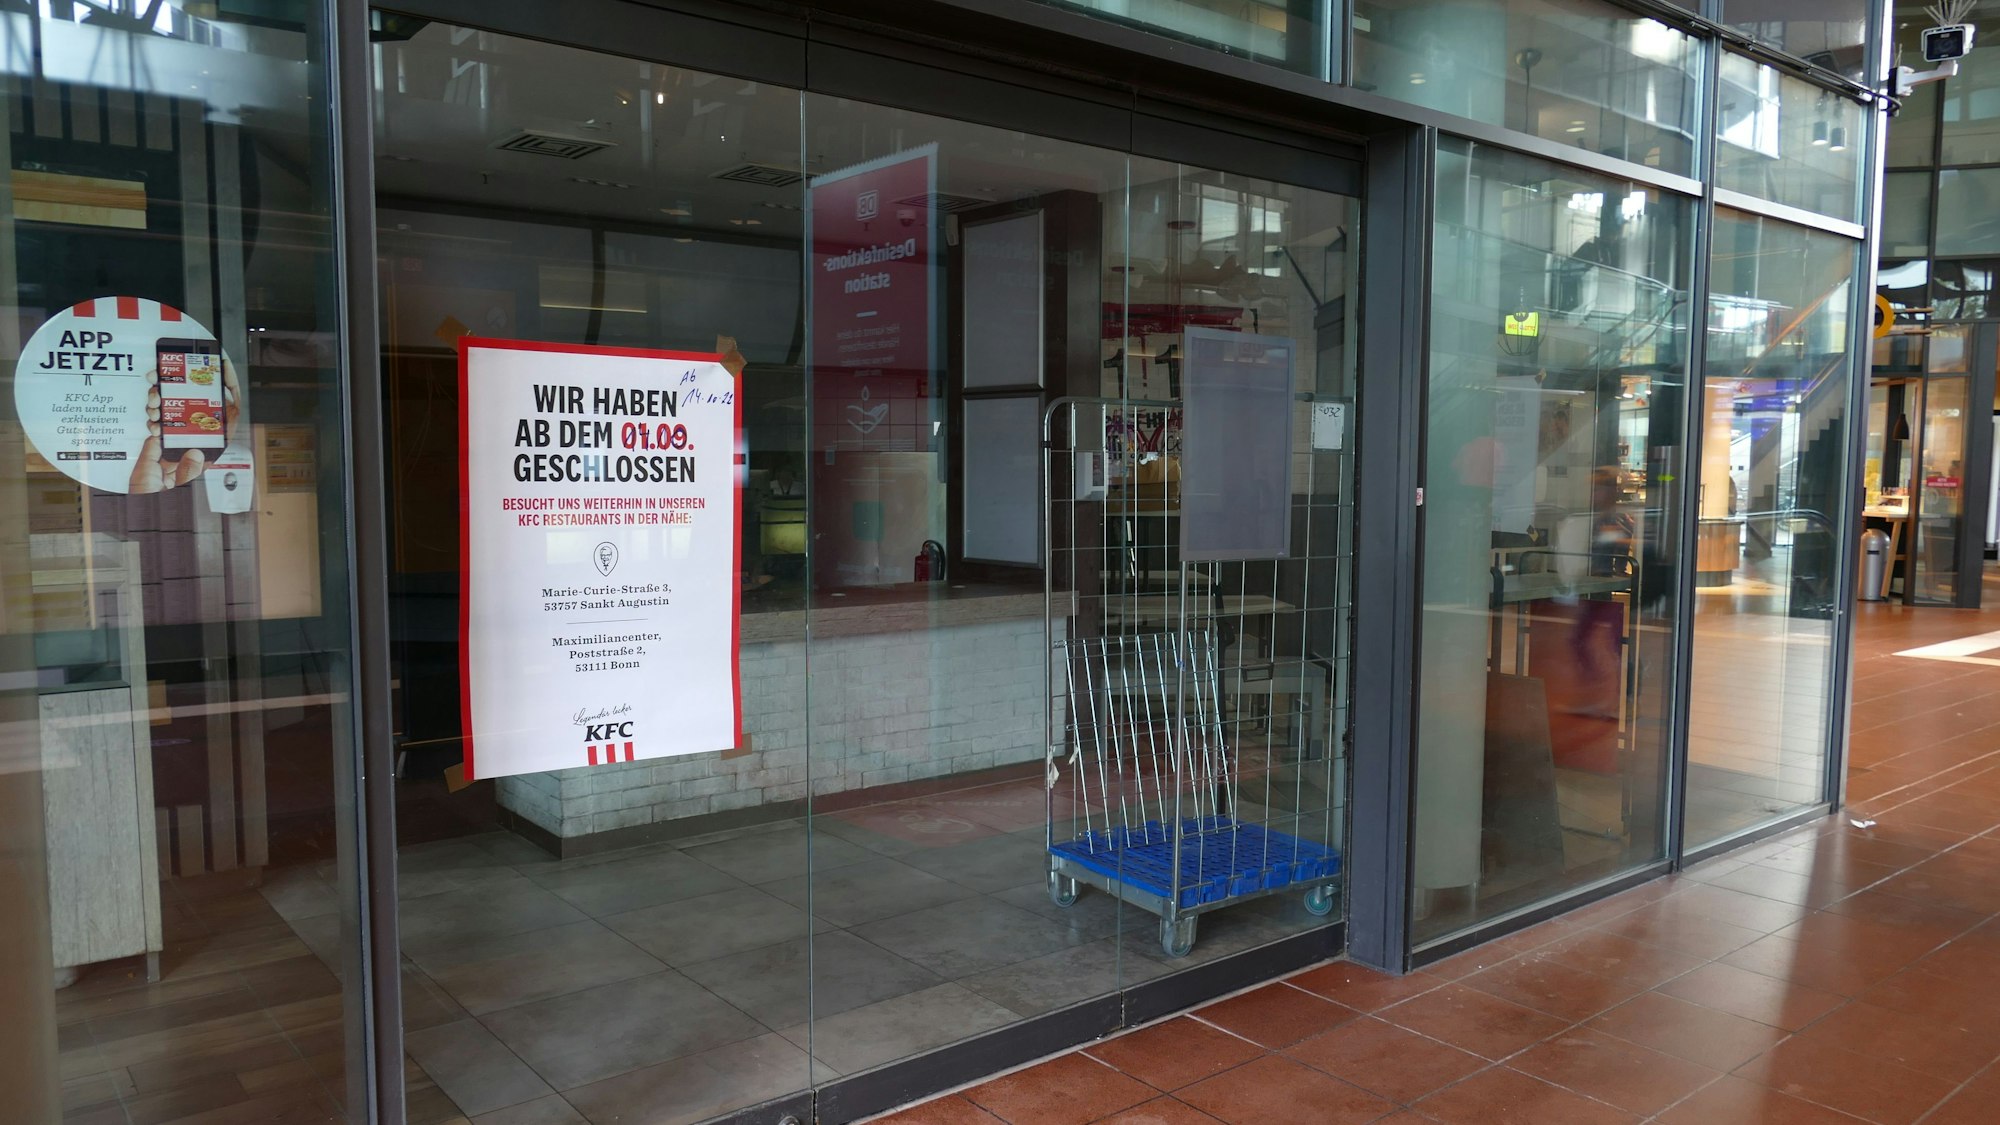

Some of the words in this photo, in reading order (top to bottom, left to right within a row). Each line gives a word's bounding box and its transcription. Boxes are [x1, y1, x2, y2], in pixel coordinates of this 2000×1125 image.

[59, 330, 113, 349] APP
[39, 351, 134, 371] JETZT!
[680, 368, 696, 385] Ab
[64, 393, 90, 402] KFC
[92, 394, 114, 404] App
[164, 399, 185, 407] KFC
[533, 384, 584, 414] WIR
[593, 387, 677, 417] HABEN
[51, 404, 82, 413] laden
[85, 404, 106, 413] und
[108, 405, 127, 414] mit
[61, 415, 119, 424] exklusiven
[56, 425, 125, 435] Gutscheinen
[515, 419, 550, 447] AB
[559, 420, 612, 448] DEM
[71, 437, 112, 446] sparen!
[513, 454, 696, 482] GESCHLOSSEN
[503, 498, 554, 510] BESUCHT
[558, 498, 580, 510] UNS
[583, 498, 642, 510] WEITERHIN
[646, 498, 656, 509] IN
[659, 497, 705, 509] UNSEREN
[518, 514, 540, 526] KFC
[543, 513, 621, 526] RESTAURANTS
[624, 513, 635, 525] IN
[638, 513, 658, 524] DER
[661, 510, 692, 524] NÄHE:
[541, 584, 660, 597] Marie-Curie-Straße
[662, 583, 672, 594] 3,
[544, 601, 578, 611] 53757
[580, 599, 615, 610] Sankt
[617, 596, 670, 608] Augustin
[552, 633, 662, 647] Maximiliancenter,
[569, 647, 634, 659] Poststraße
[636, 646, 646, 656] 2,
[575, 662, 607, 672] 53111
[610, 661, 640, 670] Bonn
[612, 703, 632, 716] lecker
[584, 721, 634, 742] KFC
